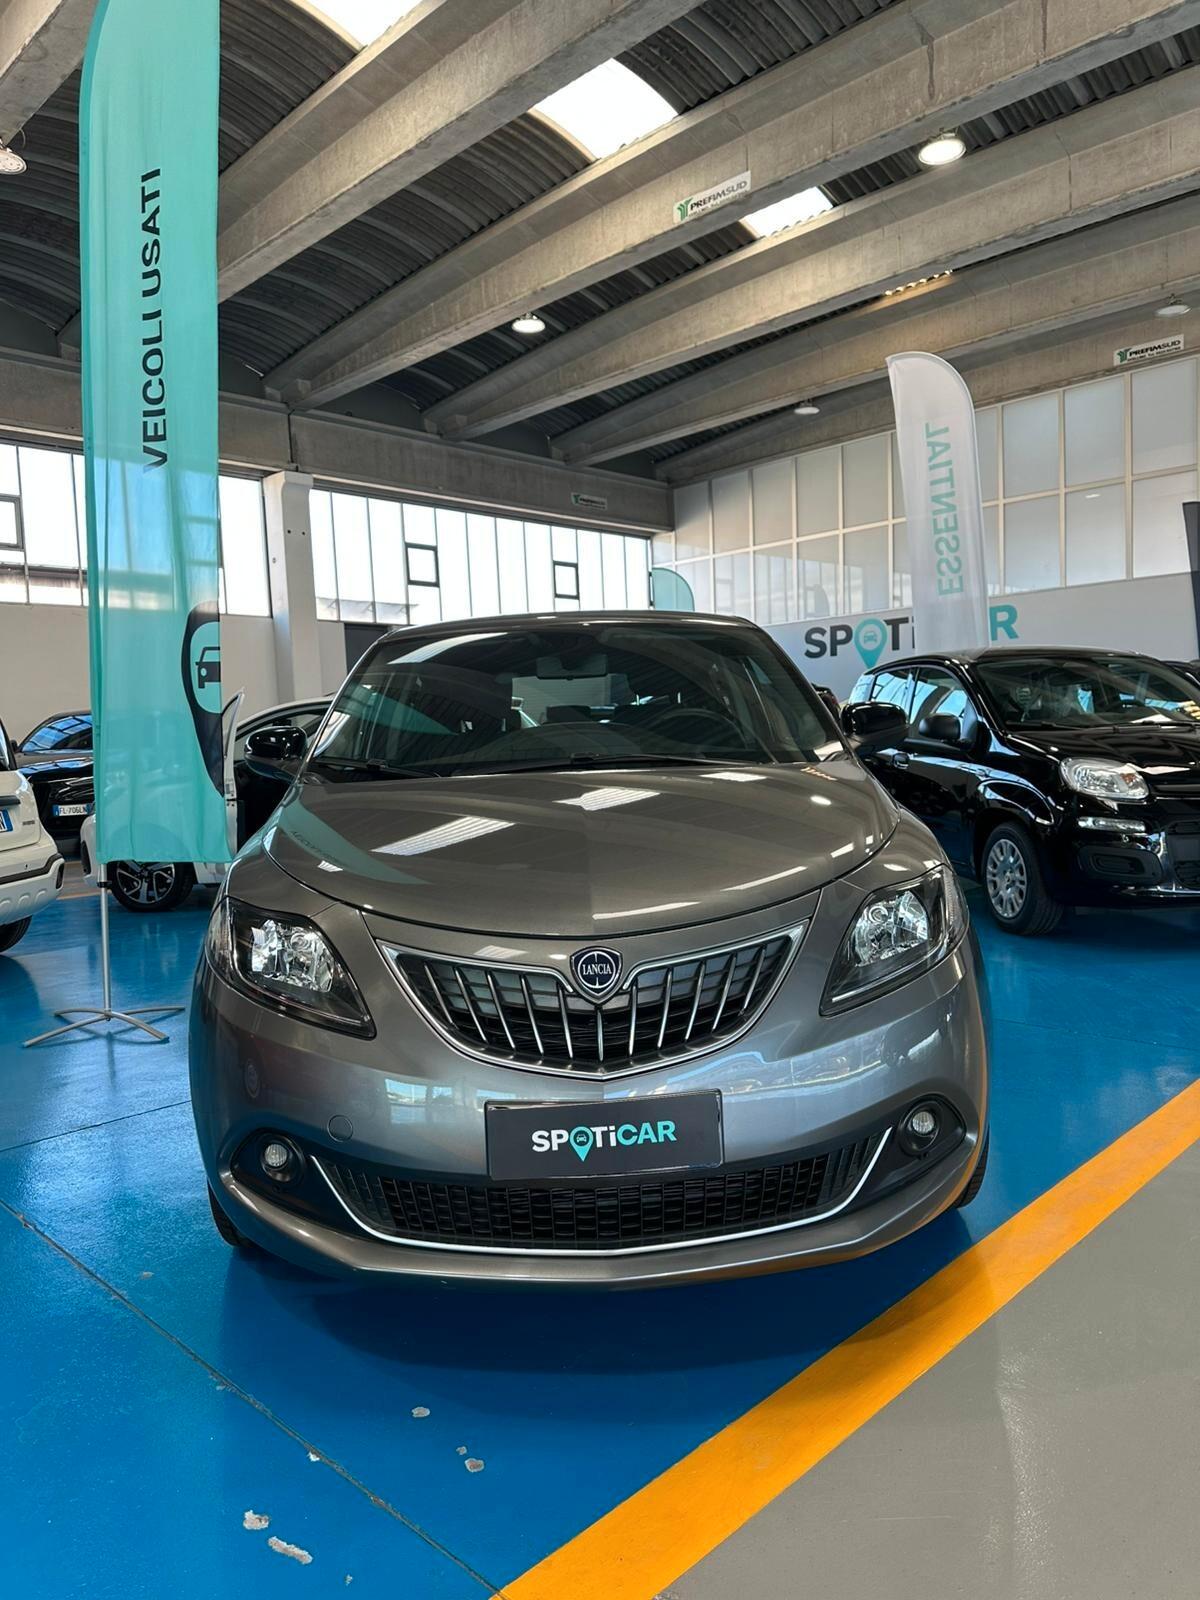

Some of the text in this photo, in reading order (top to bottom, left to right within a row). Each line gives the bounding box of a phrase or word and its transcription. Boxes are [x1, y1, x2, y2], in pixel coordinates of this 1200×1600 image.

[690, 180, 748, 211] PREFIMSUD
[141, 168, 168, 474] VEICOLI USATI
[804, 604, 1019, 669] SPOTR
[582, 963, 612, 975] LANCIA
